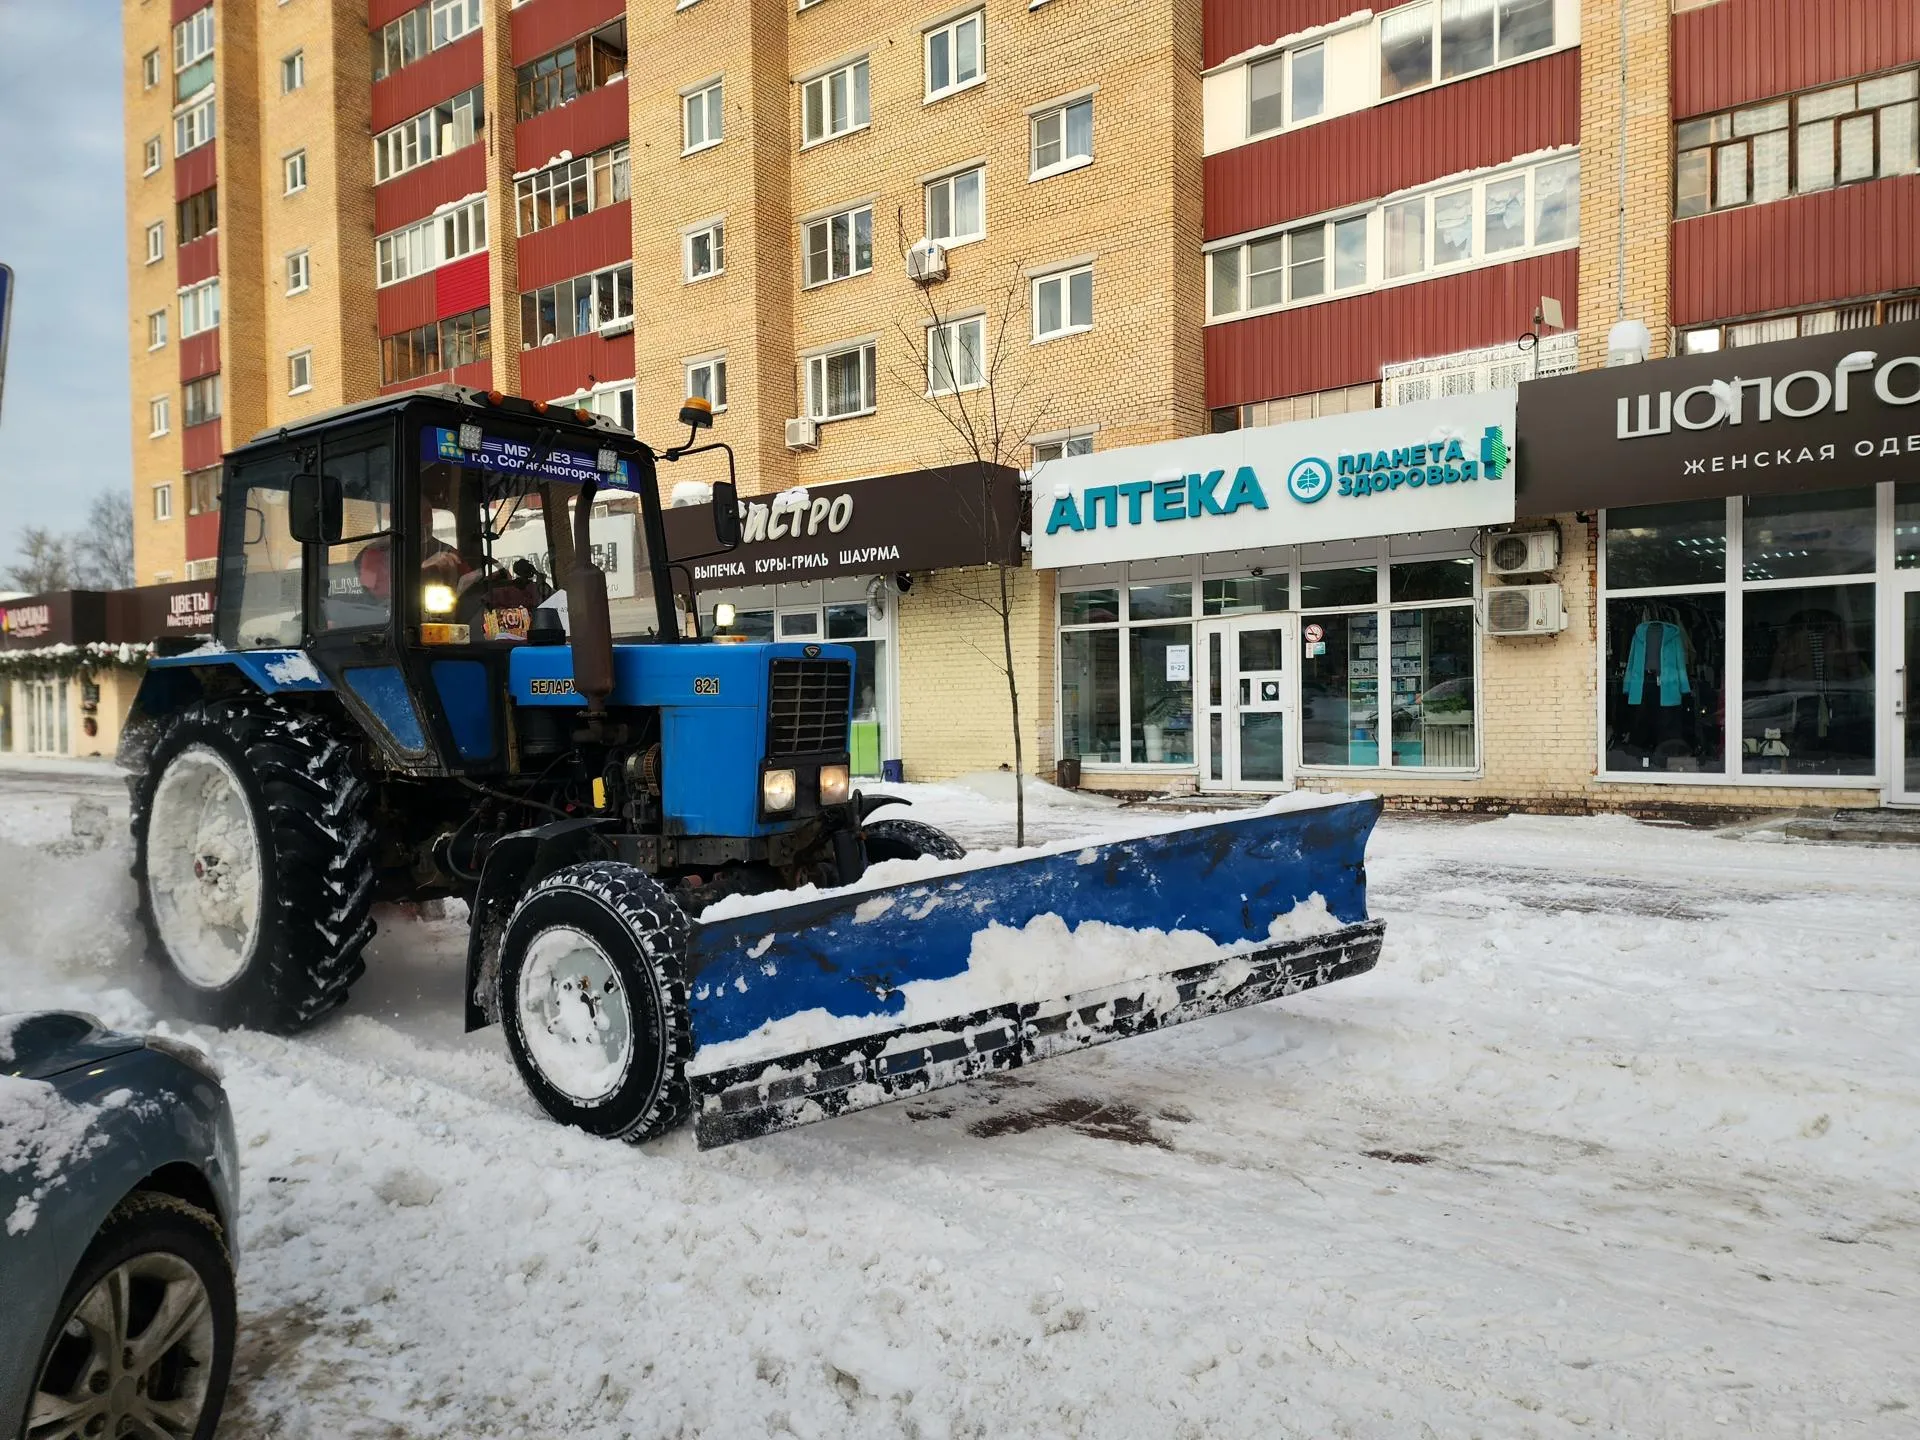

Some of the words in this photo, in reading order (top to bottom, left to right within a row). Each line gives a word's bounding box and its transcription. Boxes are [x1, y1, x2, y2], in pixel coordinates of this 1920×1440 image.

[1337, 440, 1465, 475] ПЛАНЕТА
[1683, 443, 1836, 475] ЖЕНСКАЯ
[1854, 434, 1920, 458] ОДЕ
[1337, 460, 1479, 498] ЗДОРОВЬЯ
[1045, 465, 1269, 535] АПТЕКА
[738, 493, 854, 544] ИСТРО
[694, 561, 746, 579] ВЫПЕЧКА
[755, 552, 829, 574] КУРЫ-ГРИЛЬ
[839, 545, 900, 565] ШАУРМА
[170, 592, 209, 616] ЦВЕТЫ
[531, 679, 577, 695] БЕЛАРУ
[693, 677, 720, 695] 82.1
